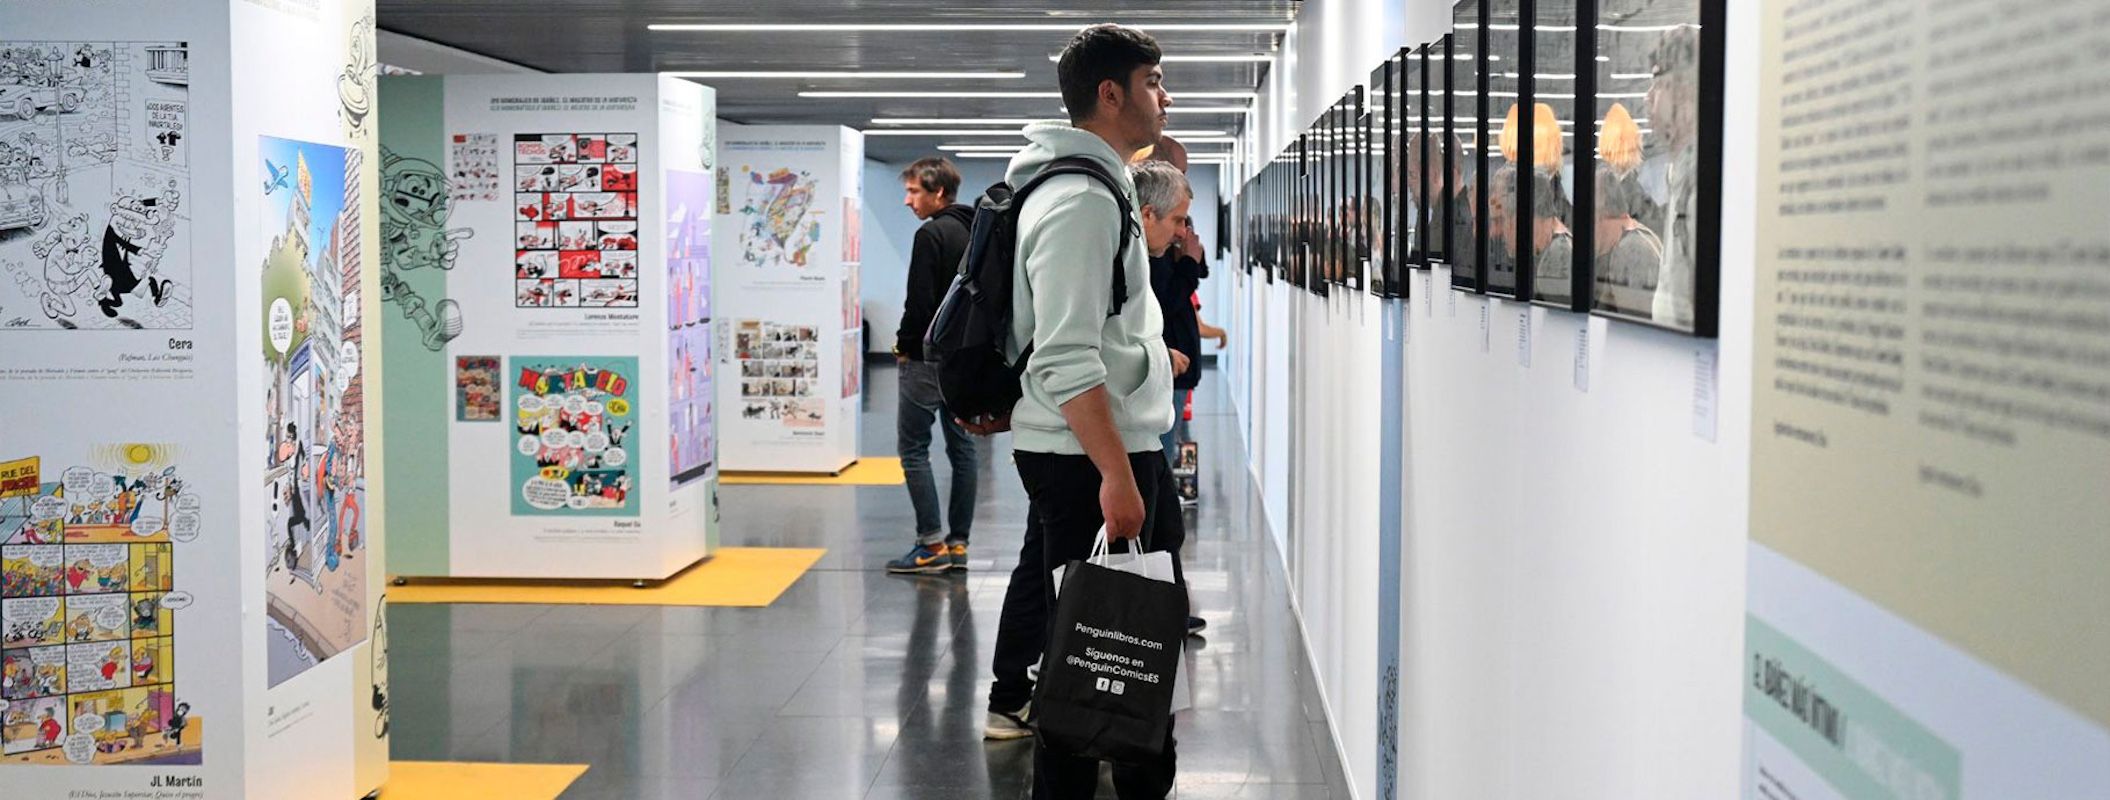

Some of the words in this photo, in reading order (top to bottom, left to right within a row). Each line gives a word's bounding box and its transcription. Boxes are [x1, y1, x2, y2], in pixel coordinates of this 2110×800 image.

[168, 338, 192, 350] Cera
[1075, 622, 1163, 650] Penguinlibros.com
[1085, 646, 1130, 665] Síguenos
[1131, 658, 1144, 668] en
[1066, 655, 1160, 684] @PenguinComicsES
[150, 775, 162, 787] JL
